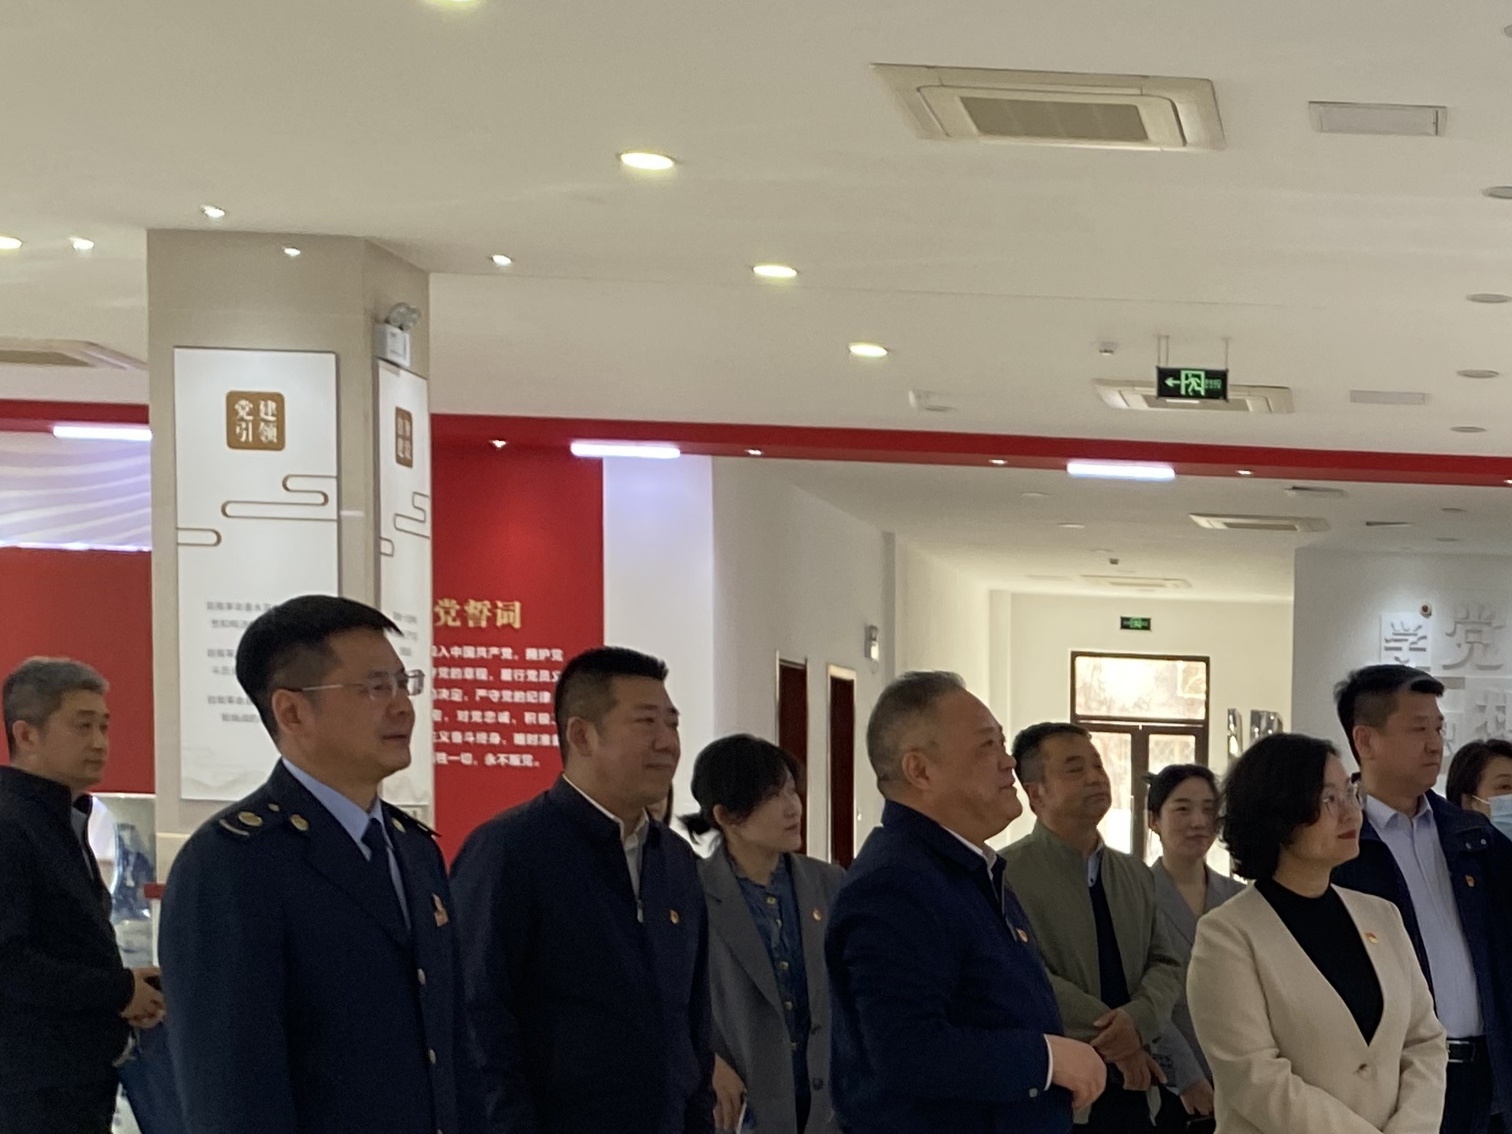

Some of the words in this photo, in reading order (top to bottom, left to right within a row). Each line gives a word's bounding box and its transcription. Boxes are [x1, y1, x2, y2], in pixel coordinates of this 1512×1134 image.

[234, 399, 278, 421] 党建
[235, 421, 278, 443] 引领
[434, 598, 521, 629] 党誓词
